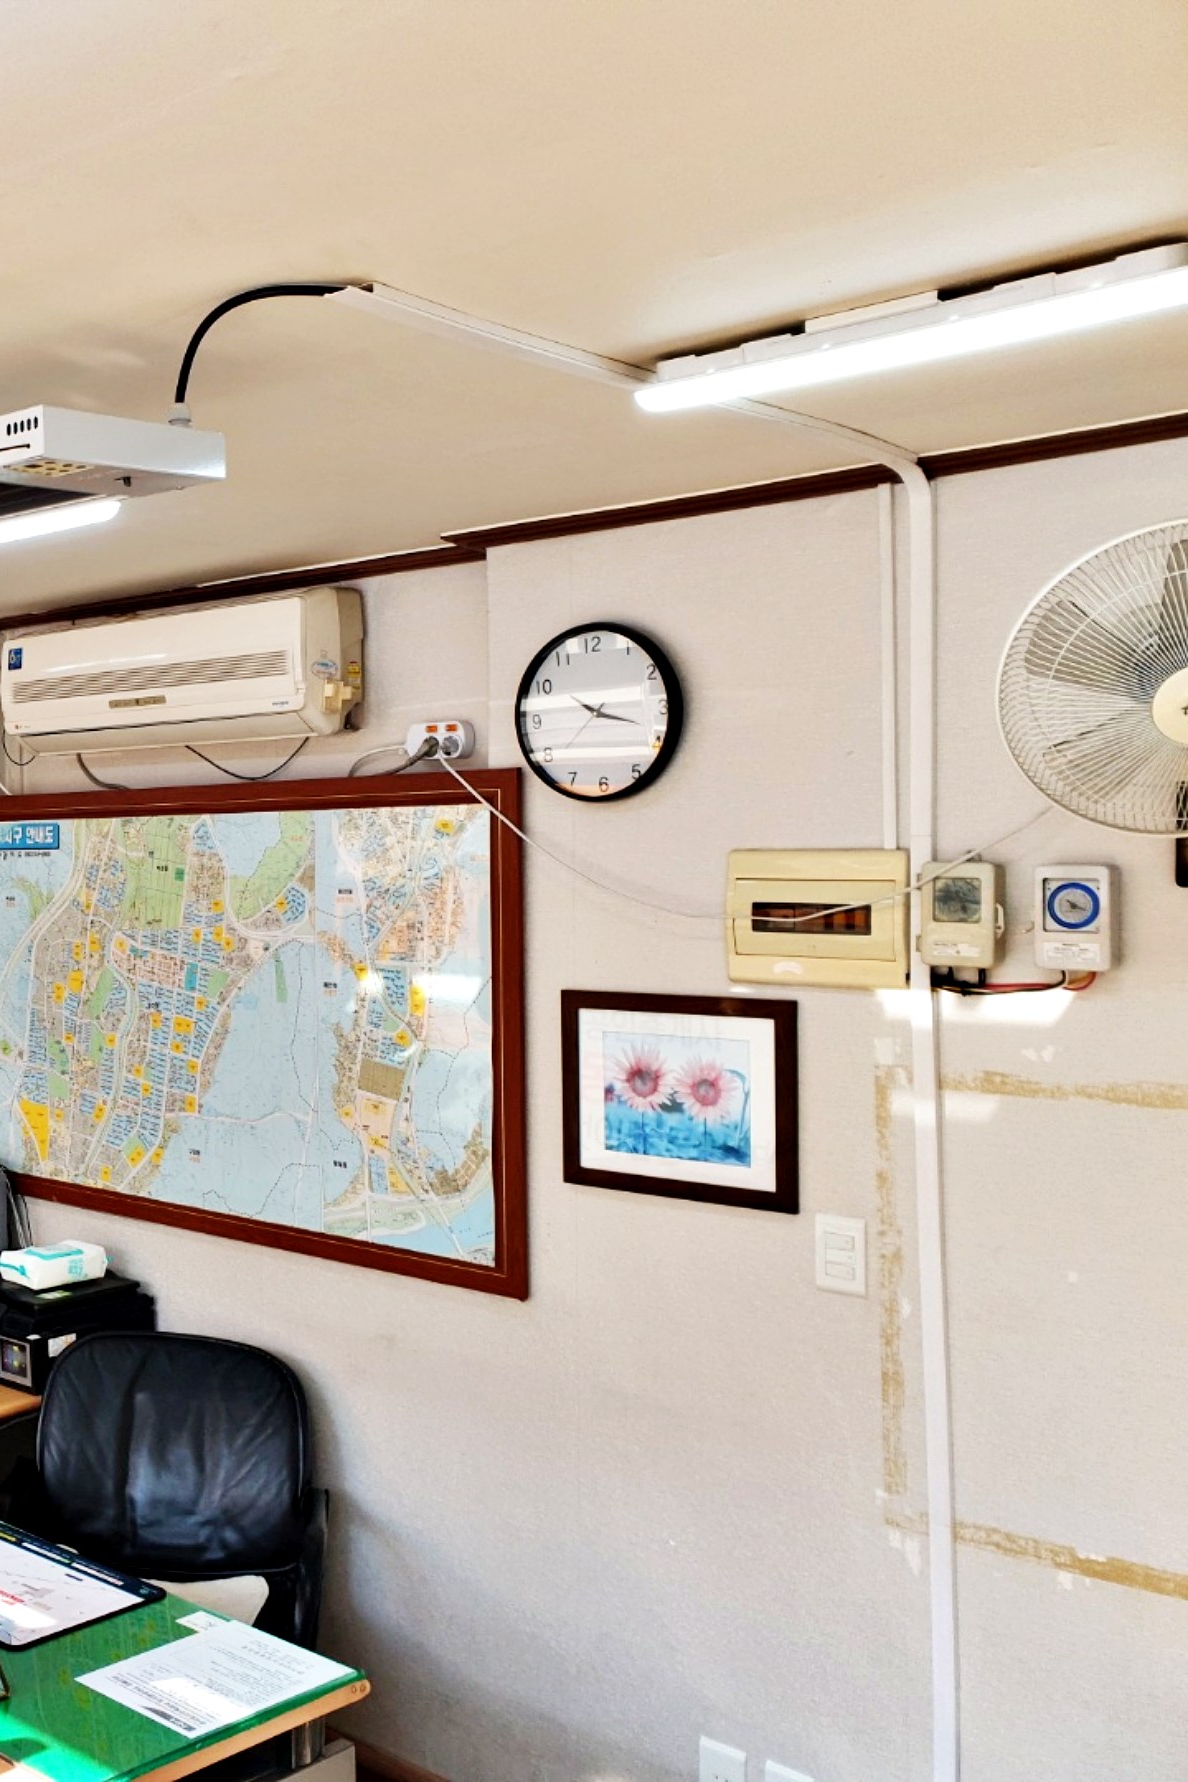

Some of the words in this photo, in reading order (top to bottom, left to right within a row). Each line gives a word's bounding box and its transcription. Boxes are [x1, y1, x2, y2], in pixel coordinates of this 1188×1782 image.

[584, 636, 602, 654] 12
[555, 651, 571, 667] 11
[646, 663, 658, 680] 2
[535, 679, 552, 695] 10
[658, 699, 669, 716] 3
[532, 714, 543, 730] 9
[543, 747, 554, 763] 8
[567, 771, 578, 787] 7
[631, 763, 642, 780] 5
[598, 776, 610, 793] 6
